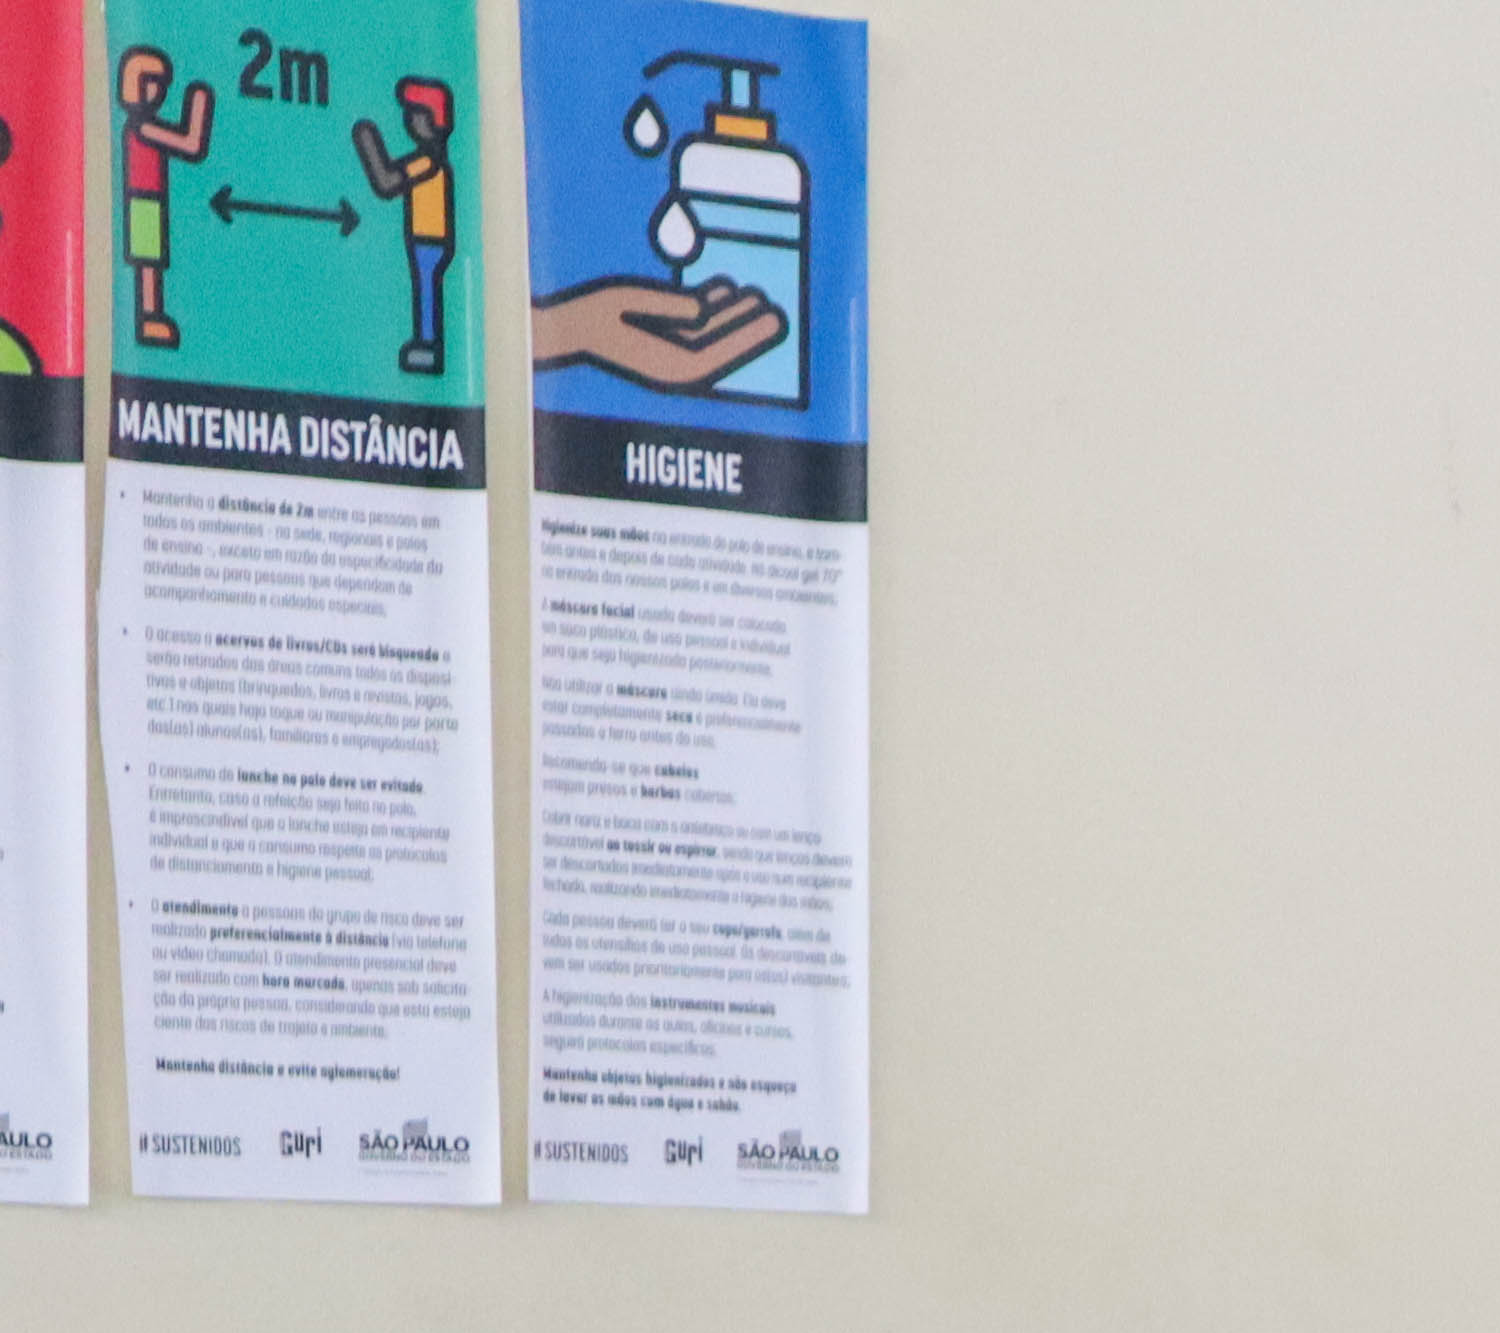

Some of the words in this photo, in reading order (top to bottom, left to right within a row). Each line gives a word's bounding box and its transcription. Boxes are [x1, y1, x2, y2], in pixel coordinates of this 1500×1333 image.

[238, 27, 329, 108] 2m
[118, 398, 292, 455] MANTENHA
[300, 414, 464, 470] DISTÂNCIA
[626, 441, 743, 494] HIGIENE
[296, 502, 314, 518] 2m
[328, 773, 356, 790] deve
[358, 1129, 399, 1151] SÃO
[402, 1134, 471, 1153] PAULO
[736, 1138, 776, 1161] SÃO
[778, 1143, 839, 1163] PAULO
